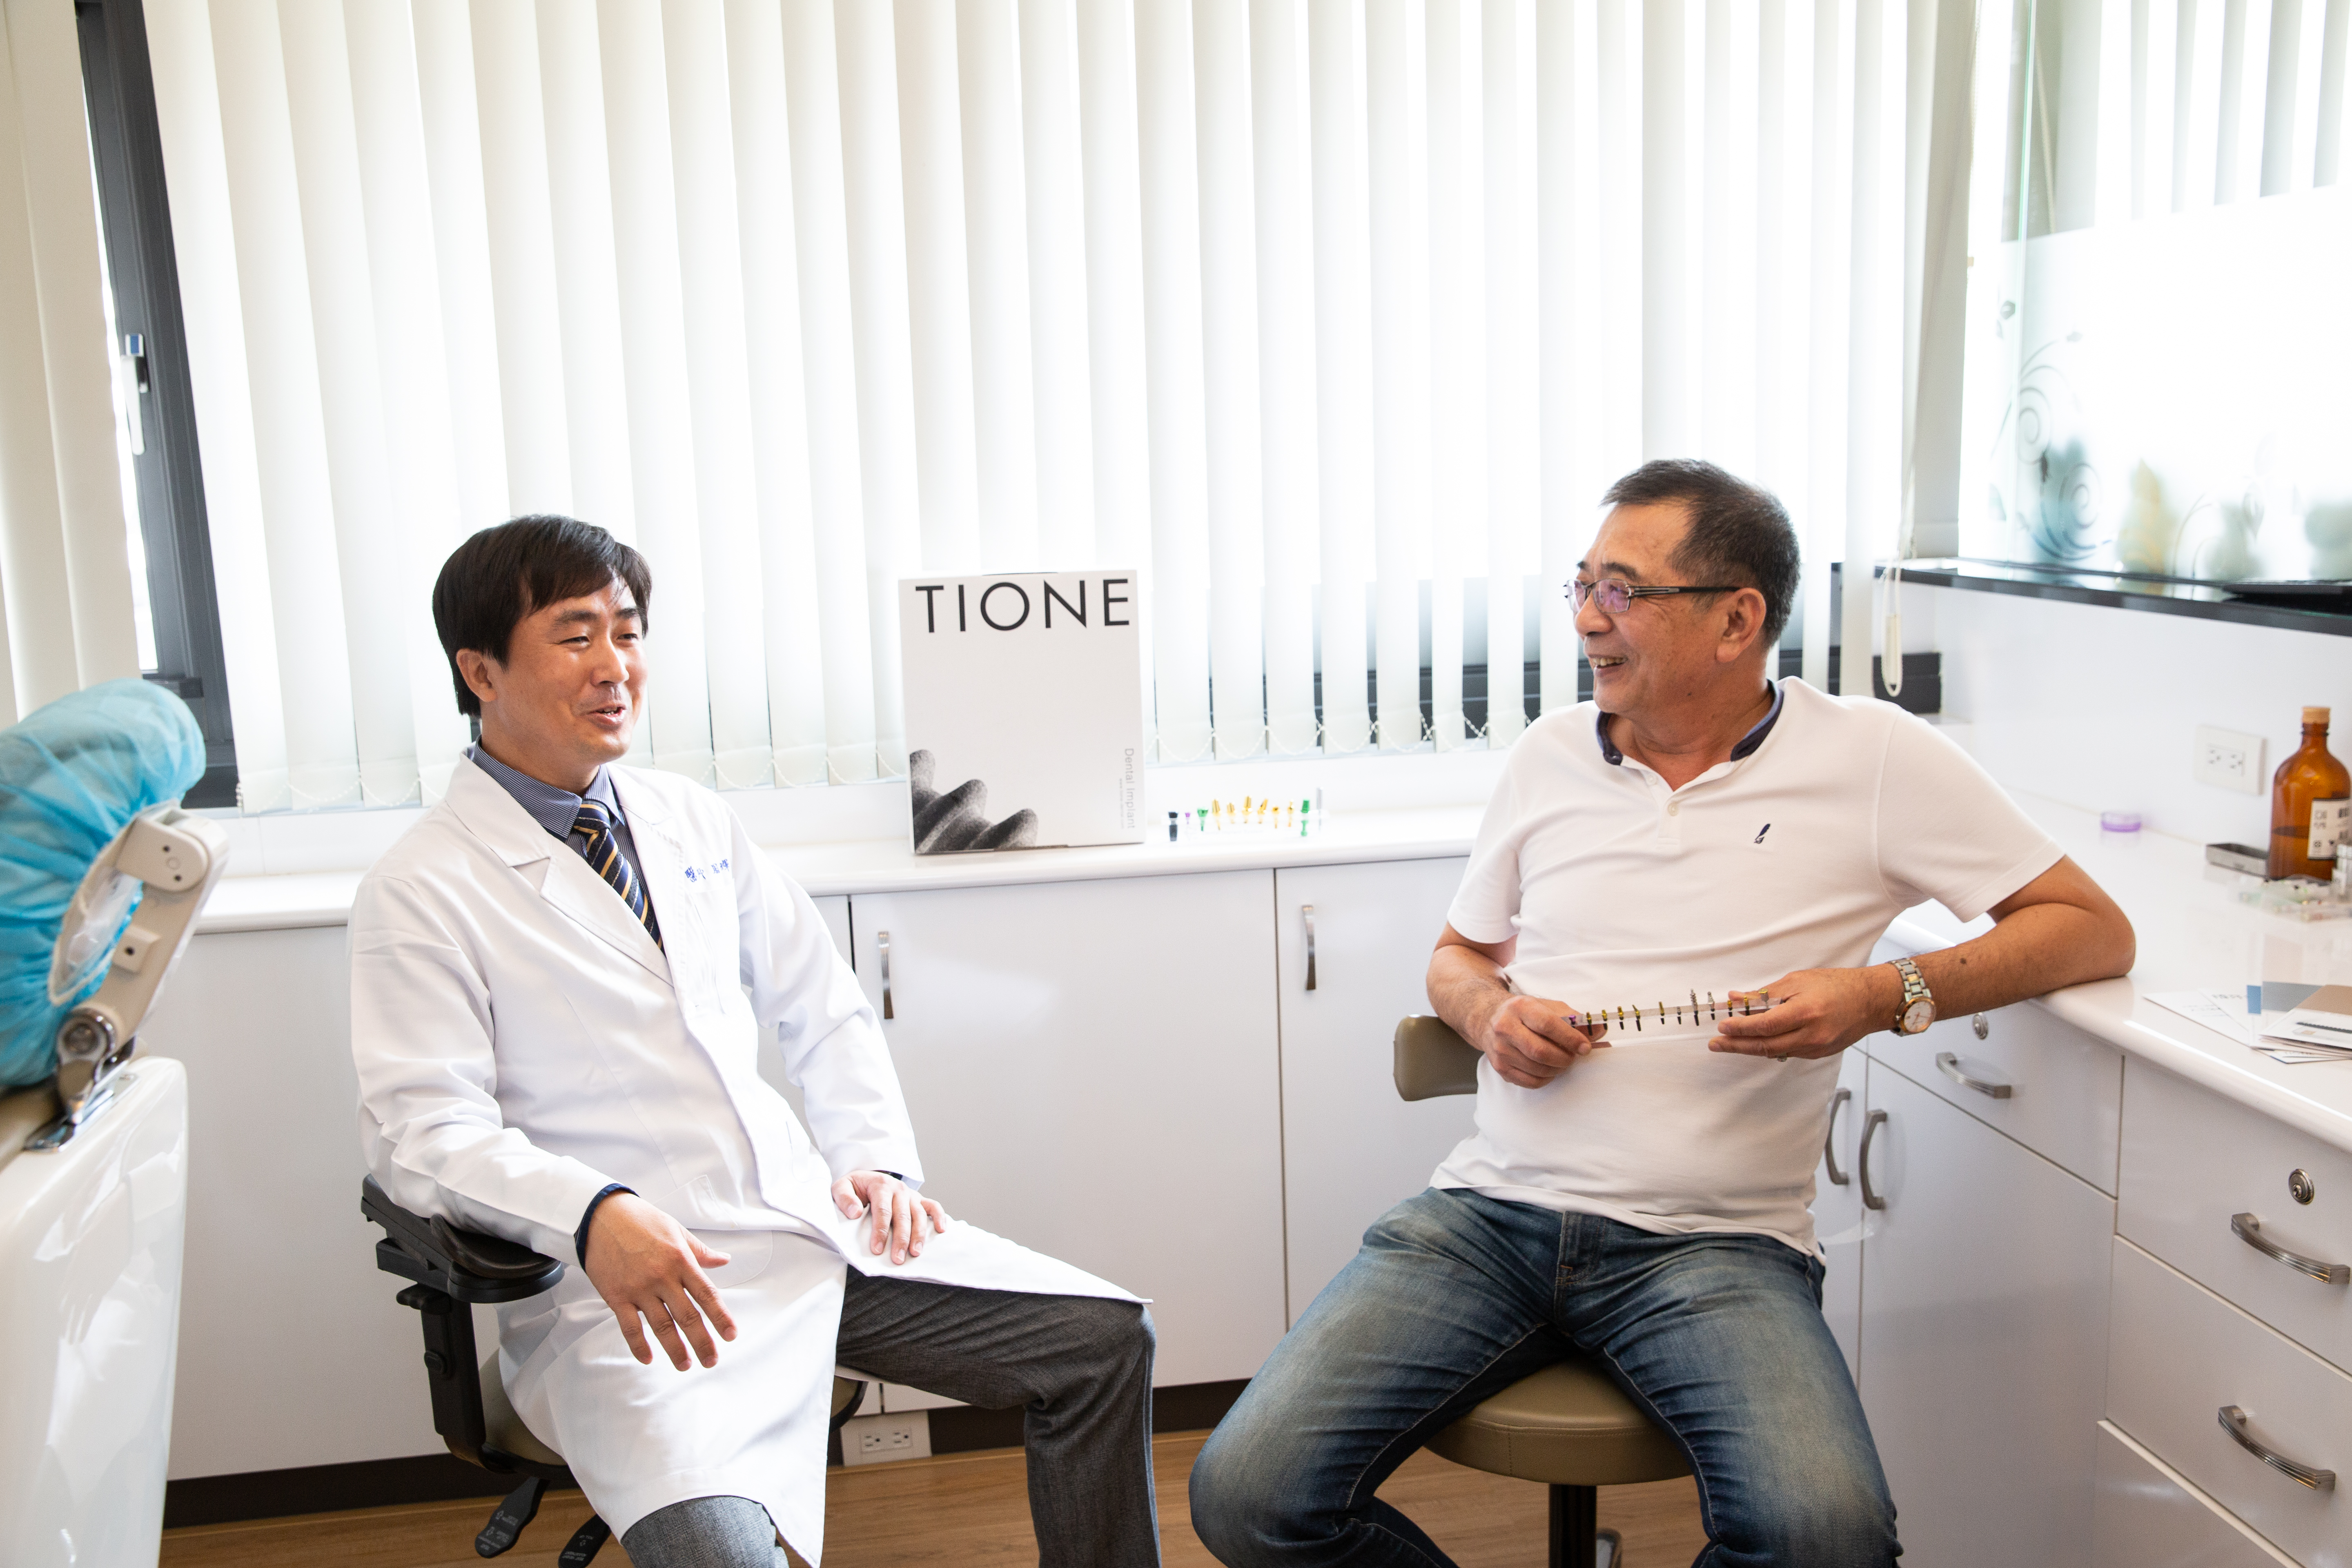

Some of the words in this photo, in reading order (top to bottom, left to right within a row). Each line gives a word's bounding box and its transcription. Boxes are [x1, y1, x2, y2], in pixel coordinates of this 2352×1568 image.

[915, 578, 1130, 633] TIONE
[1125, 748, 1135, 784] Dental
[1125, 788, 1136, 829] Implant
